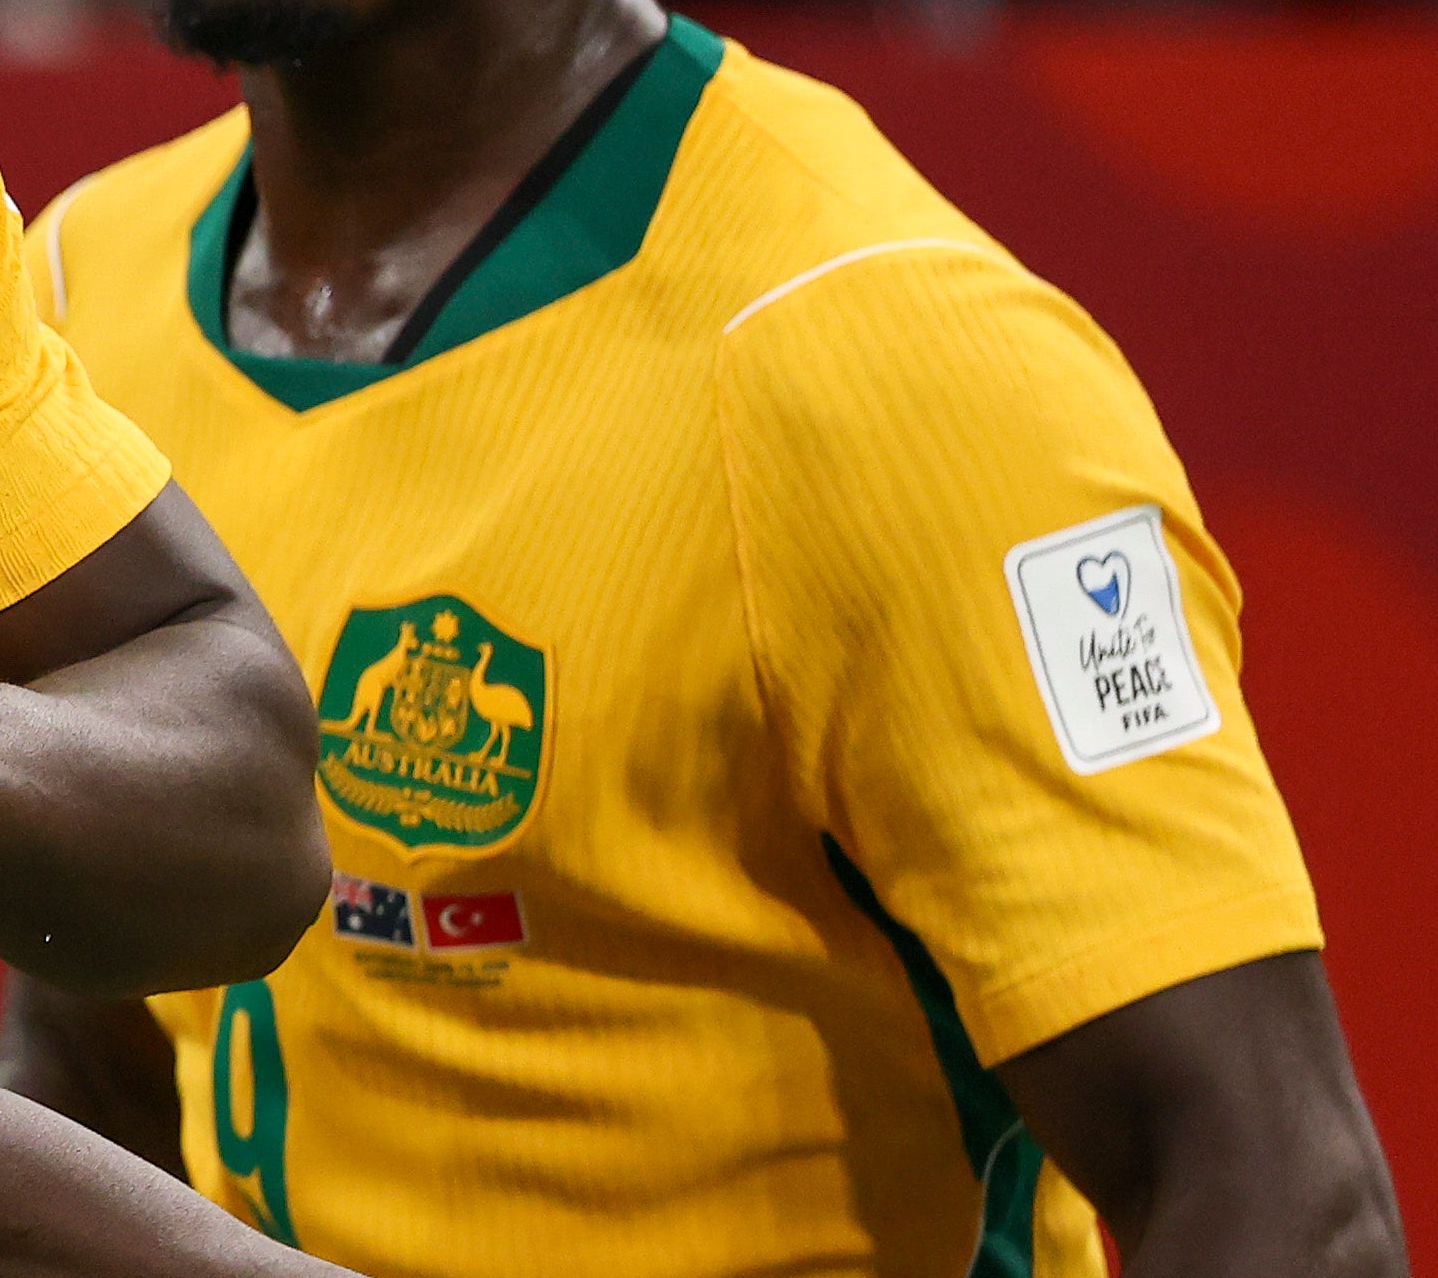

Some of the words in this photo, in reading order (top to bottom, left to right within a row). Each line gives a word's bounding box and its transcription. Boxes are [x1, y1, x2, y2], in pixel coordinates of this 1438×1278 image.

[1095, 656, 1173, 712] PEACE
[1122, 702, 1168, 731] FIFA
[342, 741, 499, 797] AUSTRALIA
